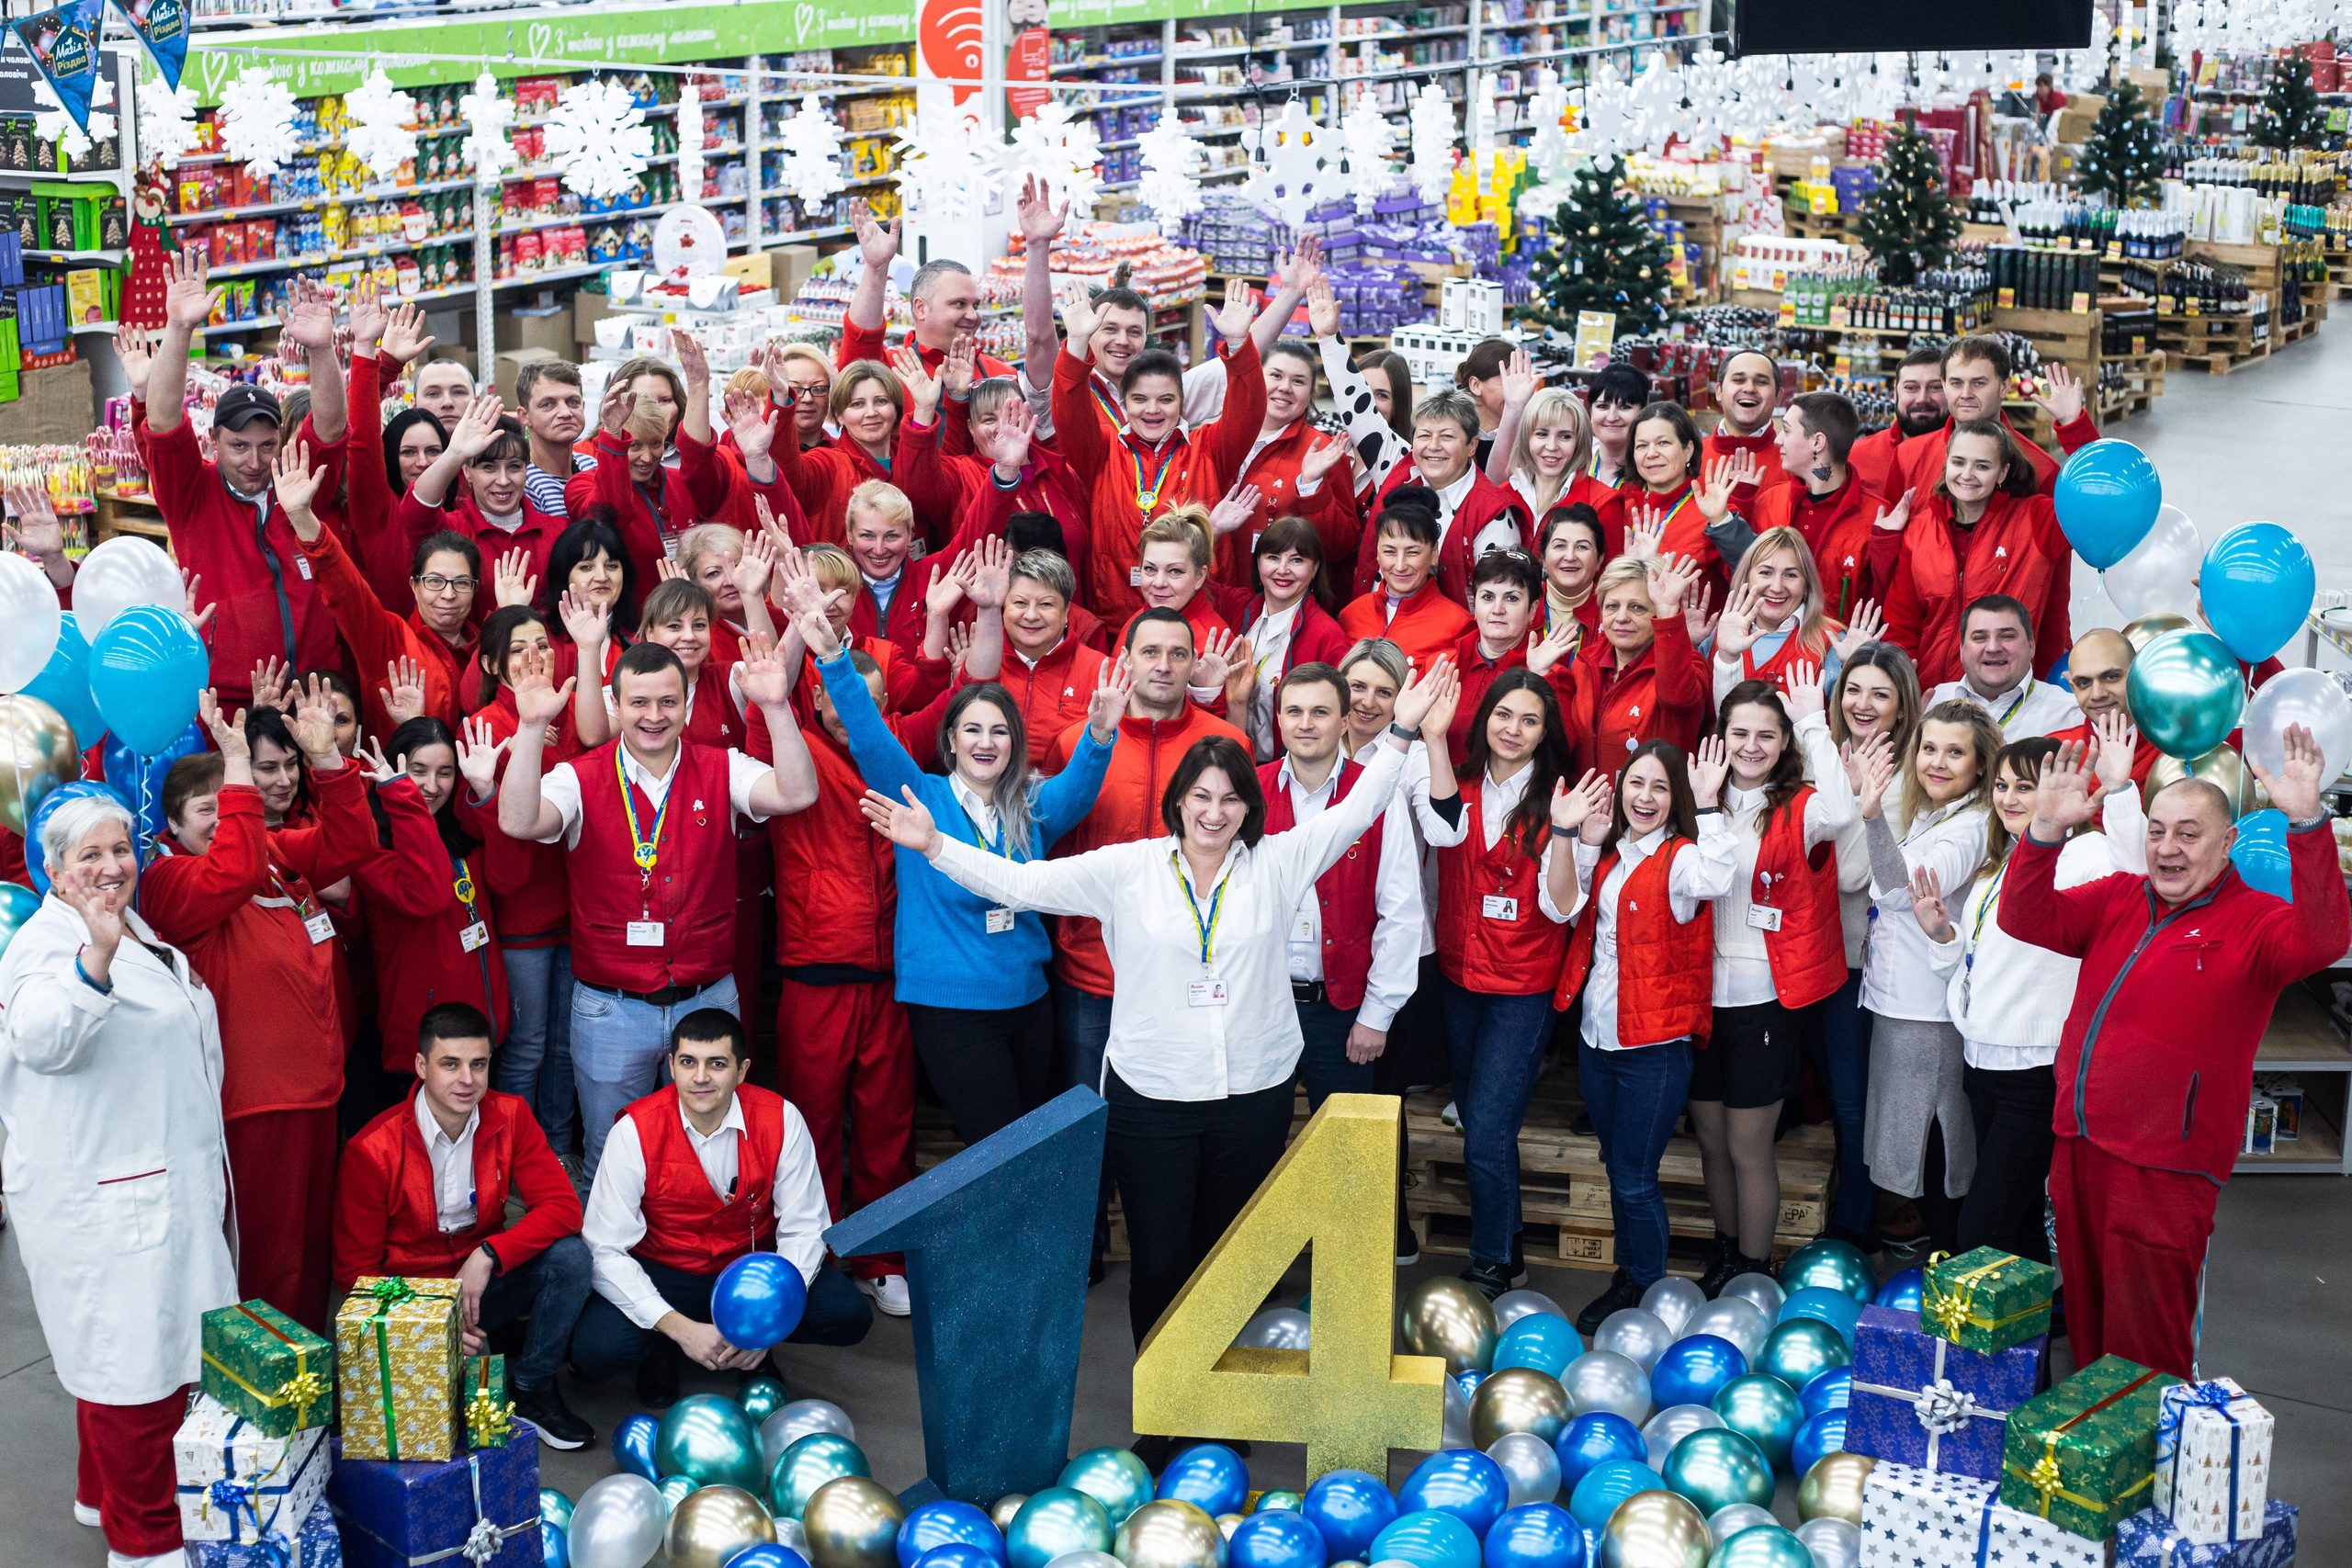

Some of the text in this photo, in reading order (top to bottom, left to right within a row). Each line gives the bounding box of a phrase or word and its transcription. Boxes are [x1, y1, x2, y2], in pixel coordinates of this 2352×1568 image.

[153, 7, 177, 25] Магія
[153, 20, 180, 36] Різдва
[55, 42, 84, 61] Магія
[57, 57, 86, 72] Різдва
[310, 59, 369, 84] кожному
